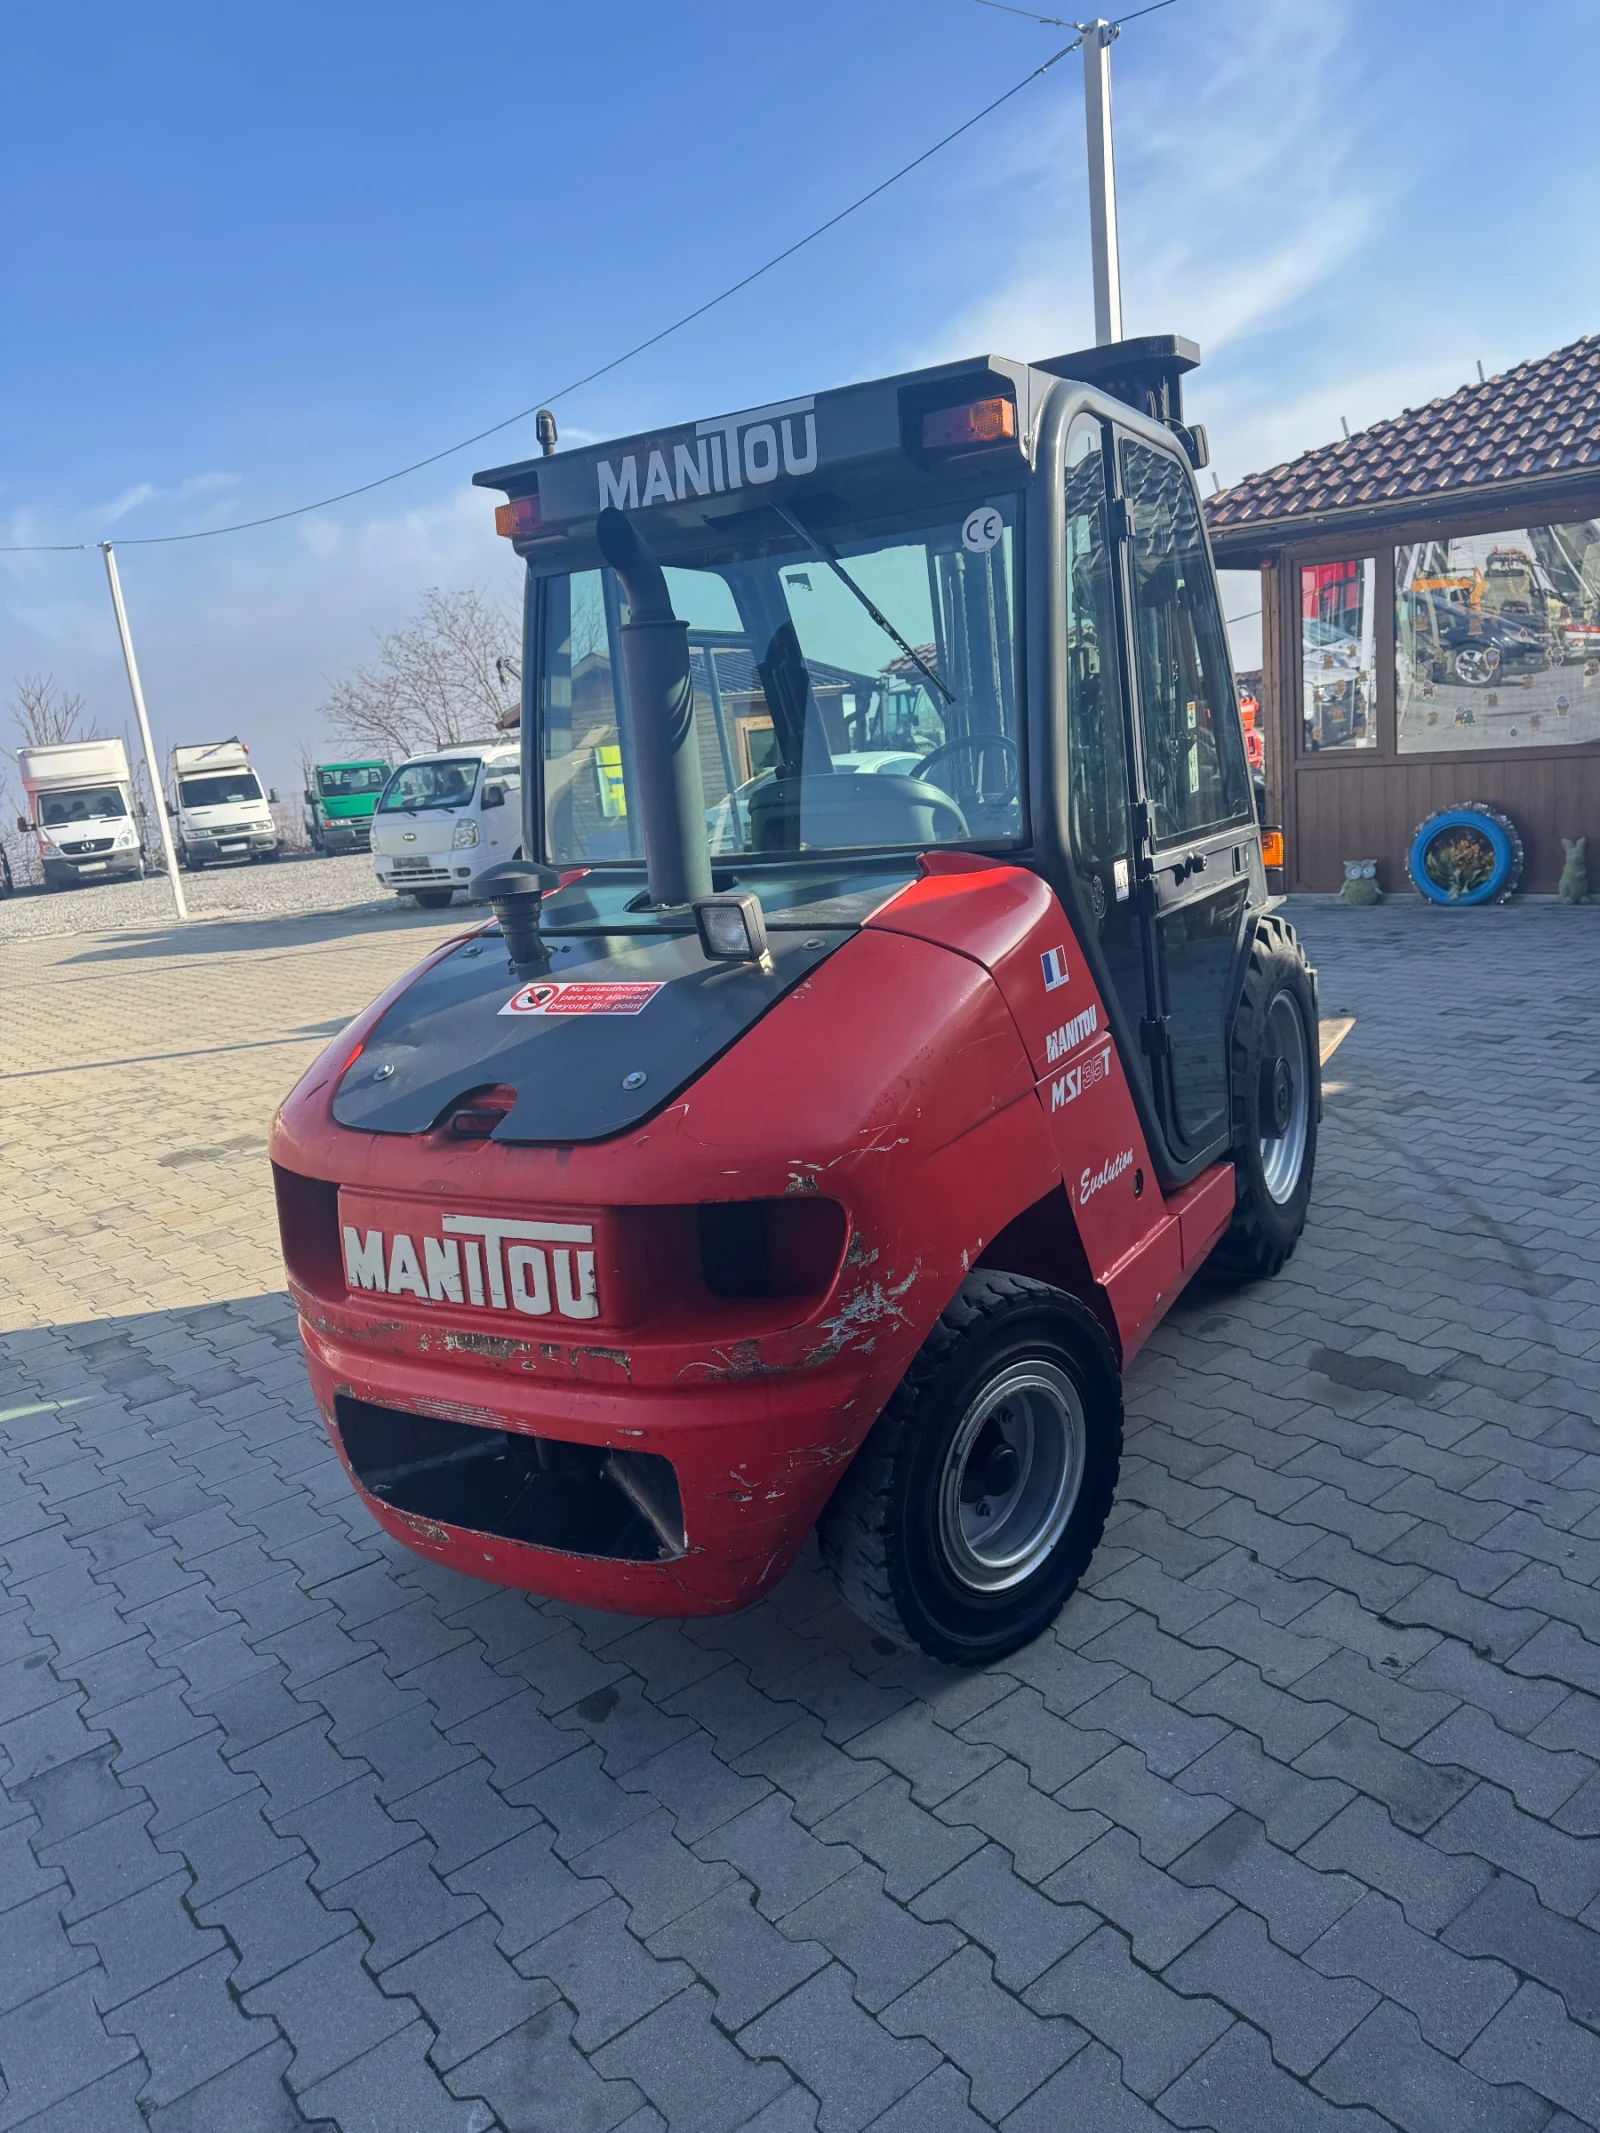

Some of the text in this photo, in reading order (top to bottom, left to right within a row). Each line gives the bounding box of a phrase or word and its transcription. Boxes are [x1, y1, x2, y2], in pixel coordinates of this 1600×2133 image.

[597, 396, 818, 511] MANITOU
[559, 994, 603, 1002] persons
[585, 984, 657, 992] unauthorised
[1046, 1004, 1097, 1063] MANITOU
[1080, 1148, 1134, 1205] Evolution
[343, 1214, 599, 1320] MANITOU
